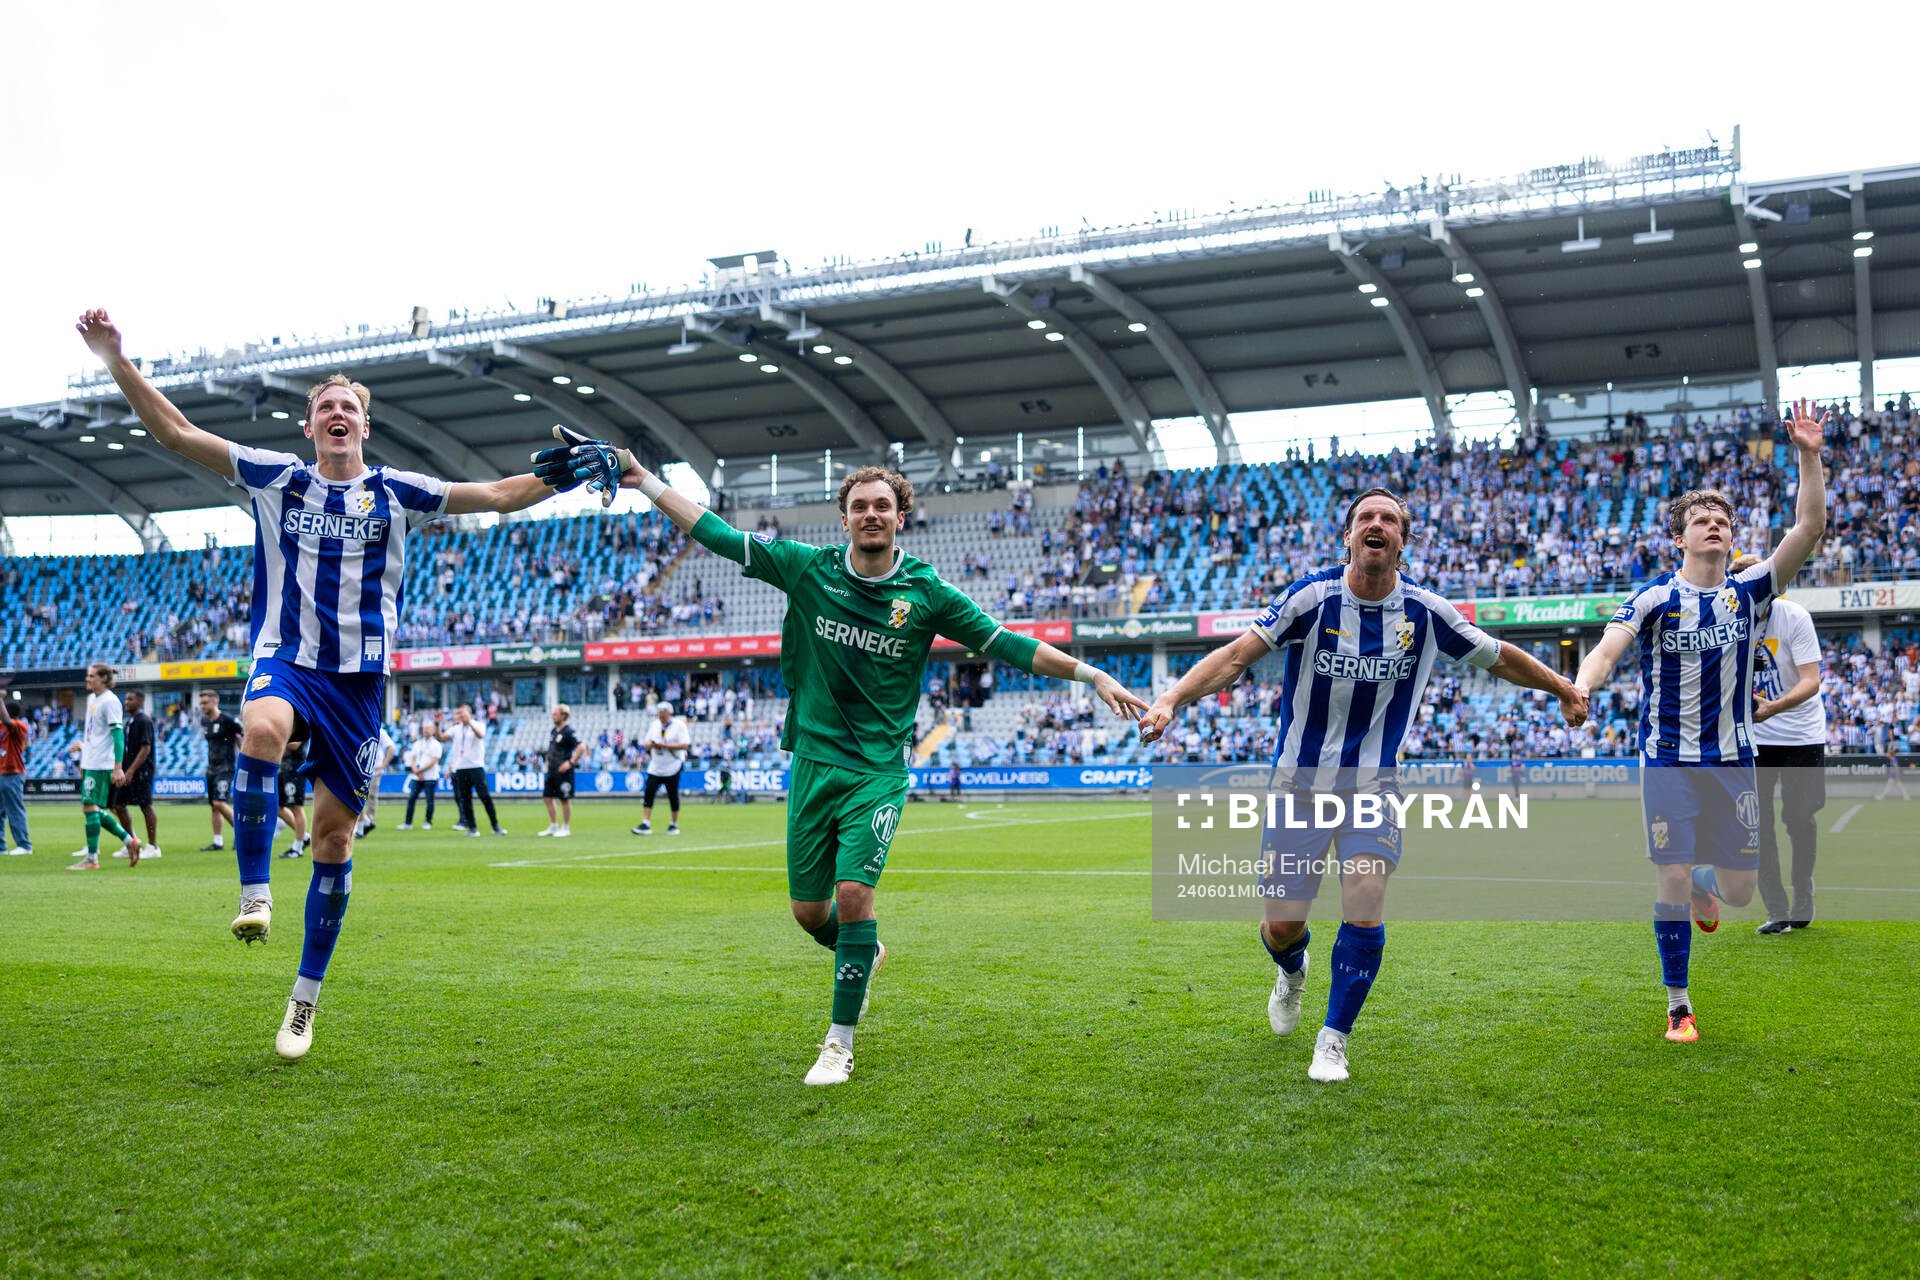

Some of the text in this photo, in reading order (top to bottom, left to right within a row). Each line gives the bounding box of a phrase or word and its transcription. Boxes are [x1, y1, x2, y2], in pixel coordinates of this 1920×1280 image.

[1624, 342, 1662, 360] F3
[1303, 372, 1340, 388] F4
[1019, 399, 1052, 414] F5
[285, 510, 384, 541] SERNEKE
[824, 584, 845, 597] CRAFT
[1840, 588, 1896, 608] FAT21
[1513, 601, 1586, 622] Picadeli
[815, 616, 907, 658] SERNEKE
[1315, 650, 1414, 682] SERNEKE
[704, 770, 783, 791] SNEKE
[1080, 769, 1137, 785] CRAFT
[1497, 762, 1628, 783] IF GÖTEBORG
[155, 778, 206, 794] GÖTEBORG
[1388, 826, 1399, 844] 13
[1747, 832, 1758, 847] 23
